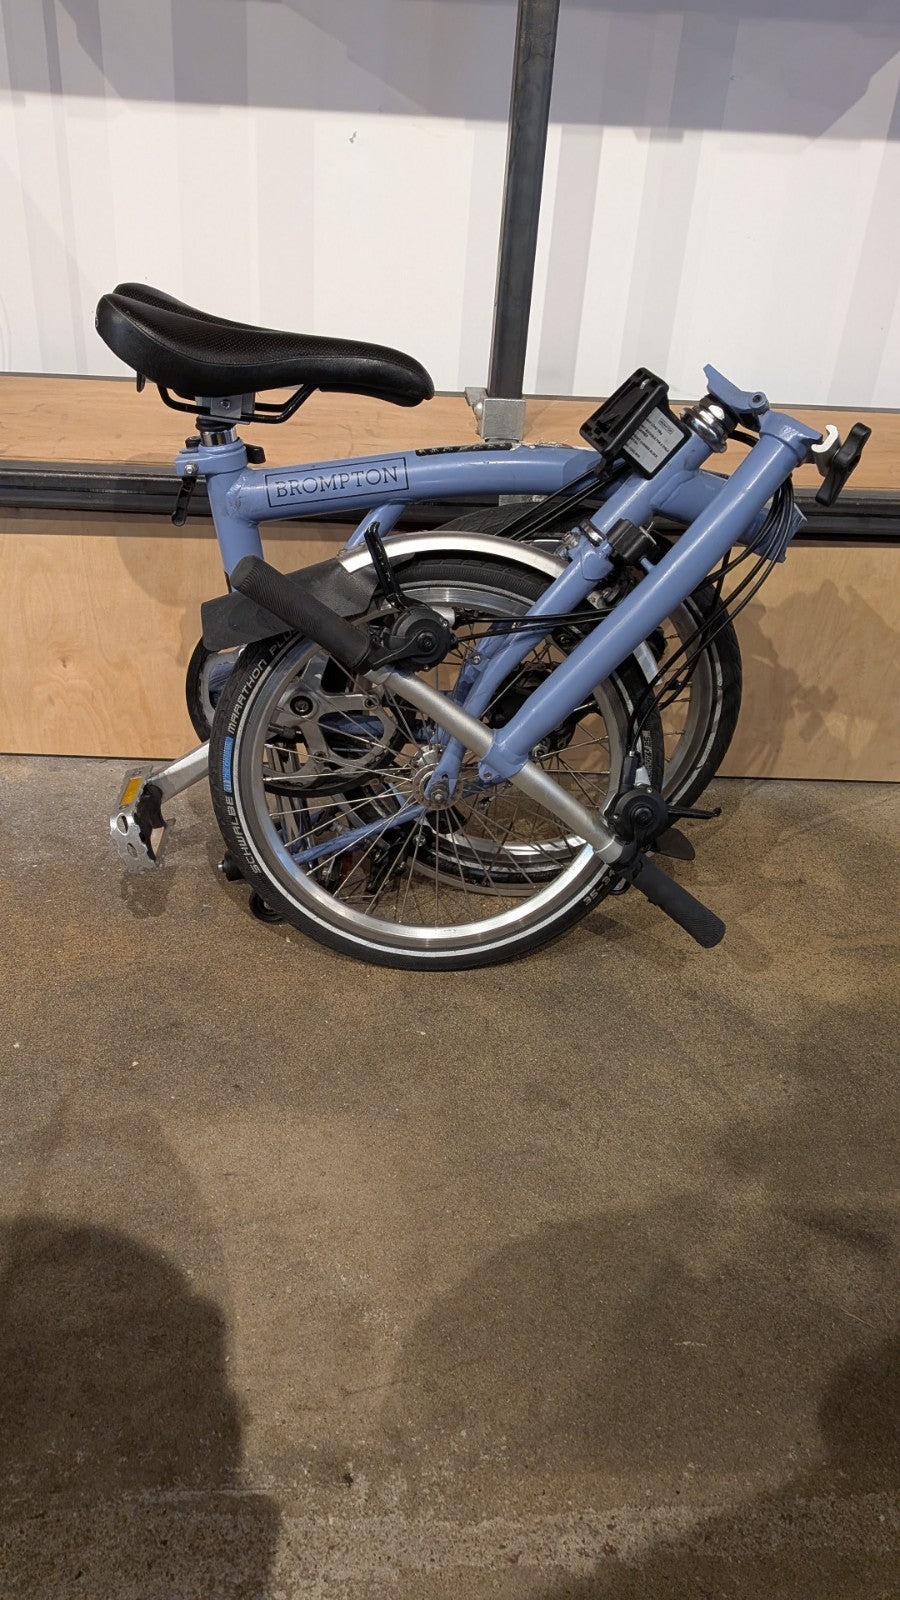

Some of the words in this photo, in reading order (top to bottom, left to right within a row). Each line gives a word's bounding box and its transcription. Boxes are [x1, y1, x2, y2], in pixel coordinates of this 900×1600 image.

[275, 466, 399, 497] BROMPTON
[228, 659, 268, 734] MARATHON
[226, 796, 262, 875] SCHWALBE
